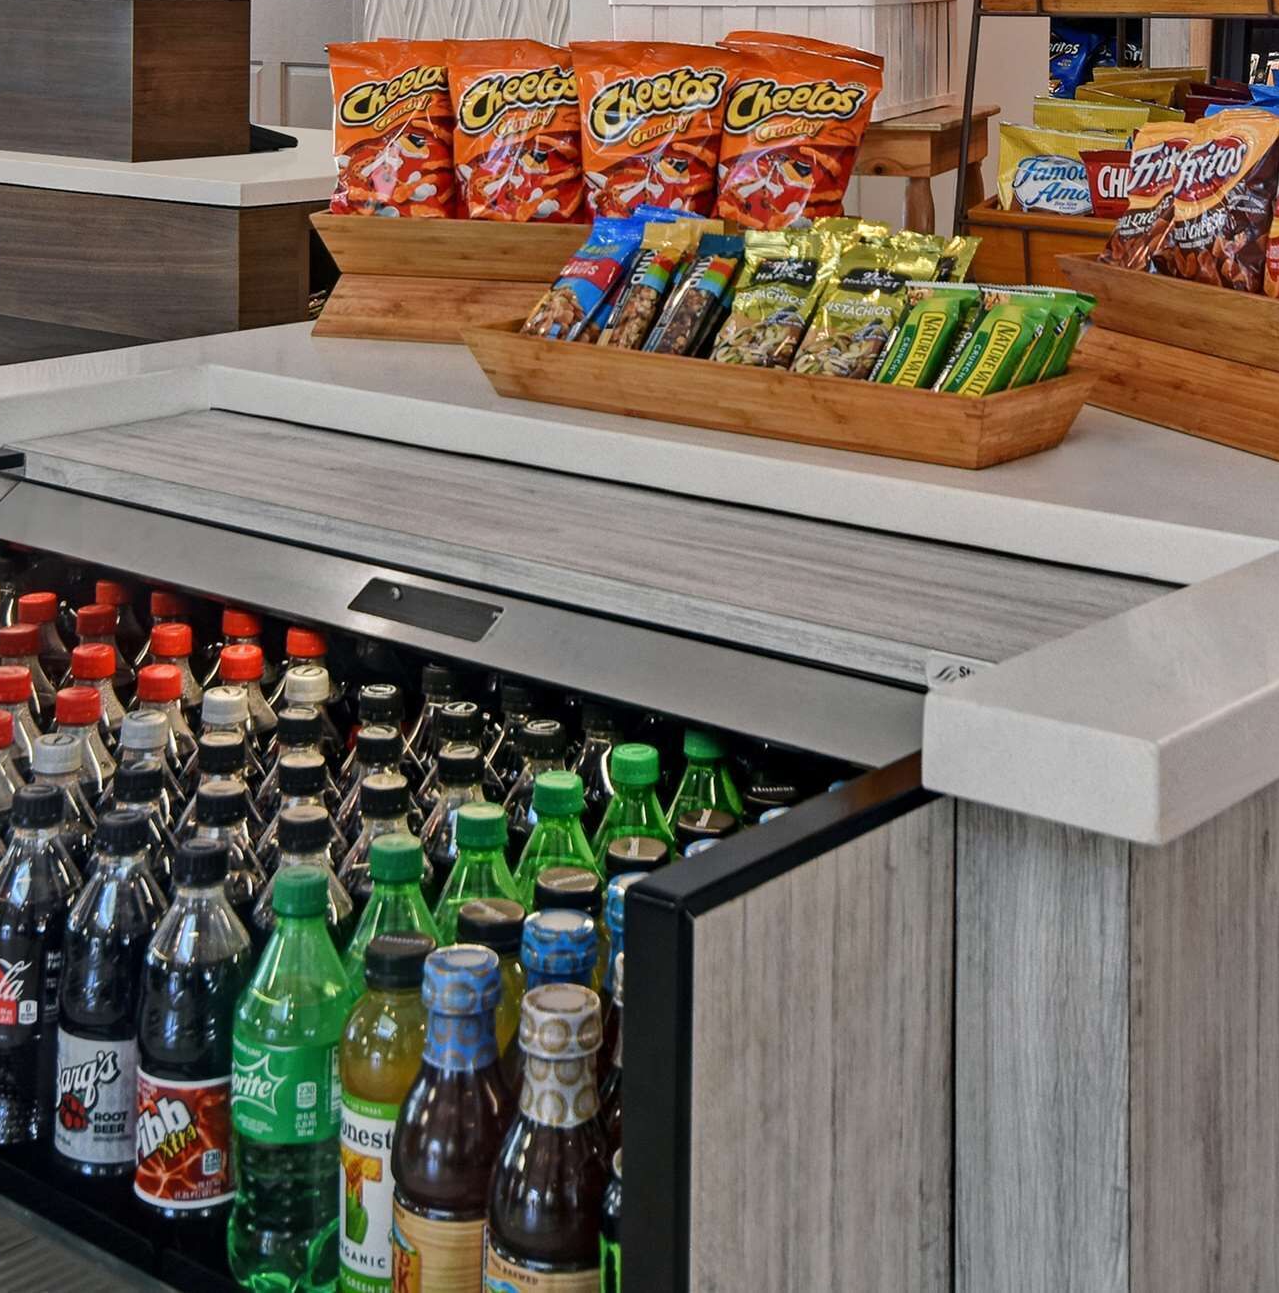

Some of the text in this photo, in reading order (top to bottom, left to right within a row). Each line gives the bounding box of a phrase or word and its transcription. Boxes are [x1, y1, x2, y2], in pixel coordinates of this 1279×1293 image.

[1049, 41, 1079, 55] ritos
[461, 67, 578, 134] Cheetos
[590, 68, 726, 141] Cheetos
[724, 80, 865, 133] Cheetos
[627, 112, 693, 147] Crunchy
[756, 119, 824, 143] Crunchy
[1012, 157, 1088, 188] Famou
[1098, 165, 1129, 198] CHI
[1130, 142, 1179, 194] Frit
[1173, 141, 1248, 195] Fritos
[1024, 181, 1091, 206] Amo
[735, 290, 808, 307] TACHIOS
[888, 336, 910, 377] CRUNCHY
[900, 315, 941, 387] NATURE VALL
[954, 343, 983, 385] CRUNCHY
[969, 323, 1017, 396] NATURE VALL
[57, 1049, 121, 1111] arq's
[231, 1071, 273, 1099] prite
[93, 1123, 126, 1134] BEER
[94, 1110, 129, 1122] ROOT
[136, 1096, 192, 1159] ibb
[341, 1120, 392, 1151] onest
[340, 1240, 387, 1269] GANIC
